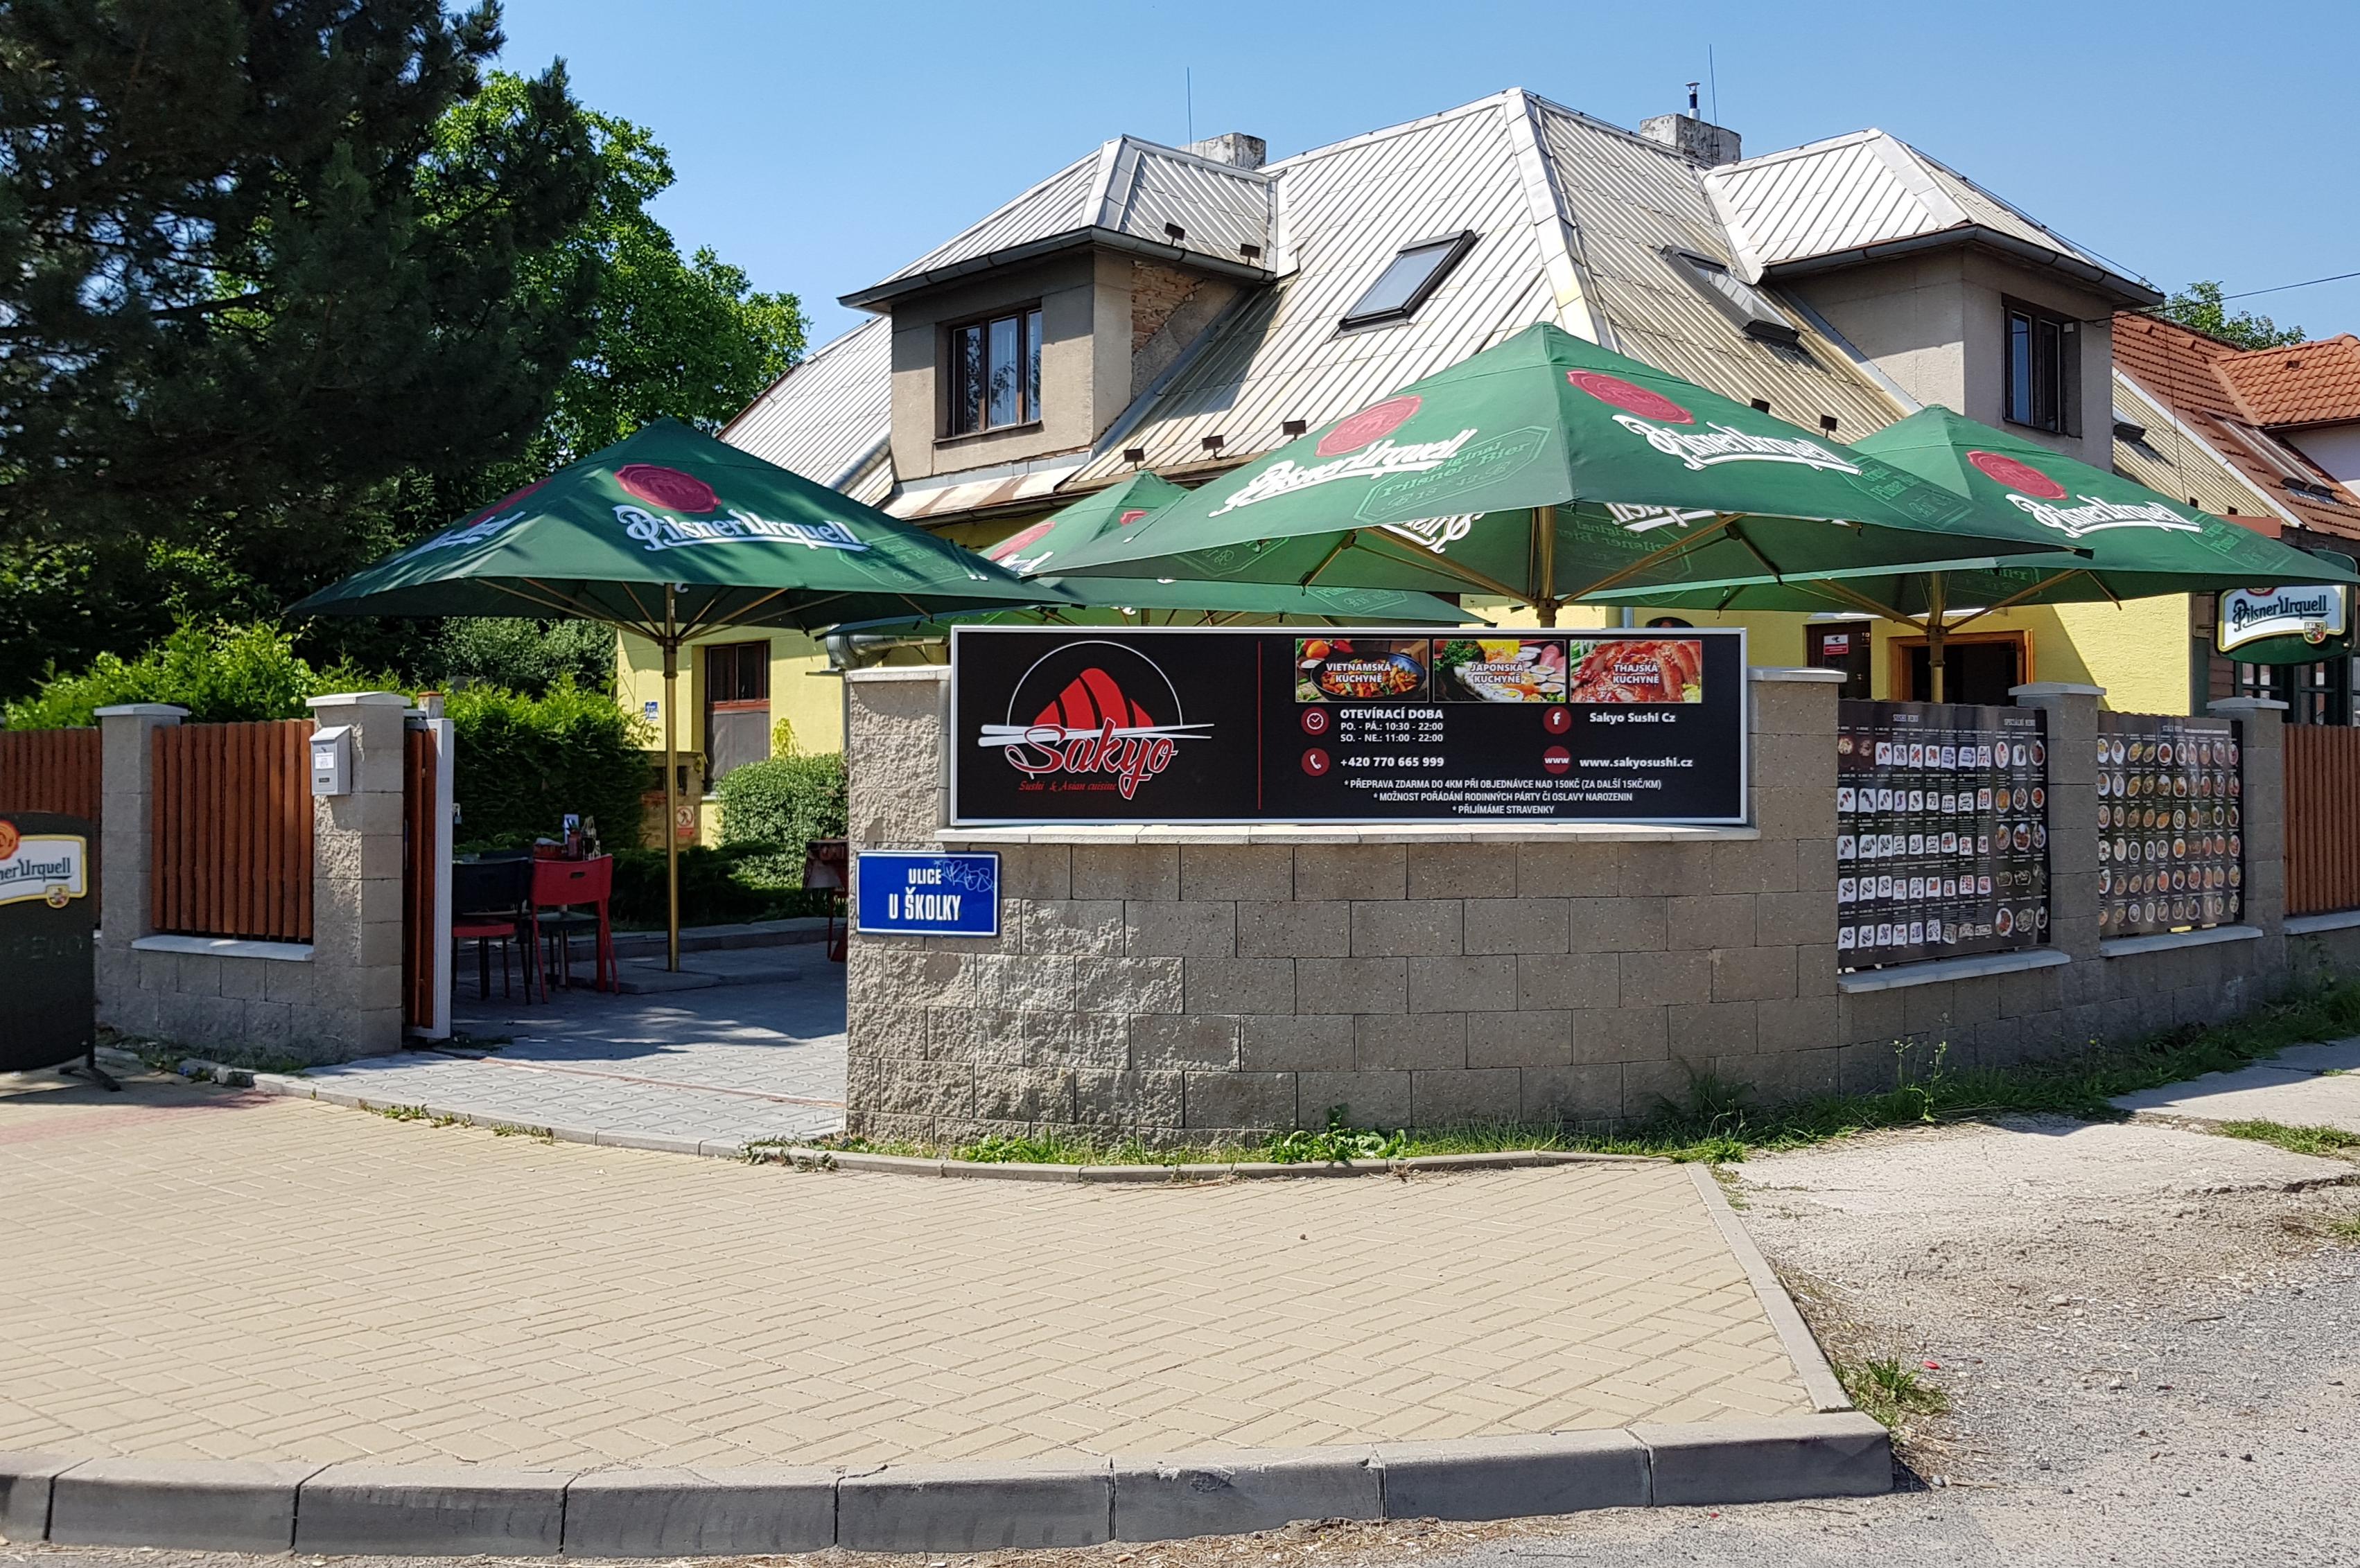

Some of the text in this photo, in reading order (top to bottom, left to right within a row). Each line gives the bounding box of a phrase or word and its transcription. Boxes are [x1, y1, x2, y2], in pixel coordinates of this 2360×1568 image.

[1612, 415, 1856, 470] Pilsner Urquell
[2005, 493, 2107, 538] Pilsner
[2077, 495, 2197, 532] Urquell
[612, 504, 862, 551] Pilsner Urquell
[2232, 594, 2327, 632] Pilsner Urquell
[1326, 661, 1391, 671] VIETNAMSKÁ
[1470, 662, 1523, 672] JAPONSKÁ
[1613, 662, 1659, 673] THAJSKÁ
[1335, 673, 1383, 683] KUCHYNĚ
[1474, 673, 1521, 684] KUCHYNĚ
[1613, 673, 1659, 684] KUCHYNĚ
[1340, 707, 1444, 719] OTEVÍRACÍ DOBA
[1589, 712, 1676, 725] Sakyo Sushi Cz
[1340, 722, 1356, 730] PO.
[1385, 722, 1410, 730] 10:30
[1418, 722, 1444, 730] 22:00
[1340, 734, 1356, 742] SO.
[1385, 734, 1410, 742] 11:00
[1418, 734, 1444, 742] 22:00
[1004, 717, 1179, 800] Sakyo
[1340, 757, 1444, 767] +420 770 665 999
[1579, 757, 1693, 770] www.sakyosushi.cz
[1350, 778, 1661, 790] PŘEPRAVA ZDARMA DO 4KM PŘI OBJEDNÁVCE NAD 150KČ (ZA DALŠÍ 15KČ/KM)
[1379, 791, 1632, 801] MOŽNOST POŘÁDÁNÍ RODINNÝCH PÁRTY ČI OSLAVY NAROZENIN
[1458, 804, 1555, 814] PŘIJÍMÁME STRAVENKY
[17, 858, 71, 882] Urquell
[908, 868, 942, 885] ULICE
[889, 886, 961, 921] U ŠKOLKY
